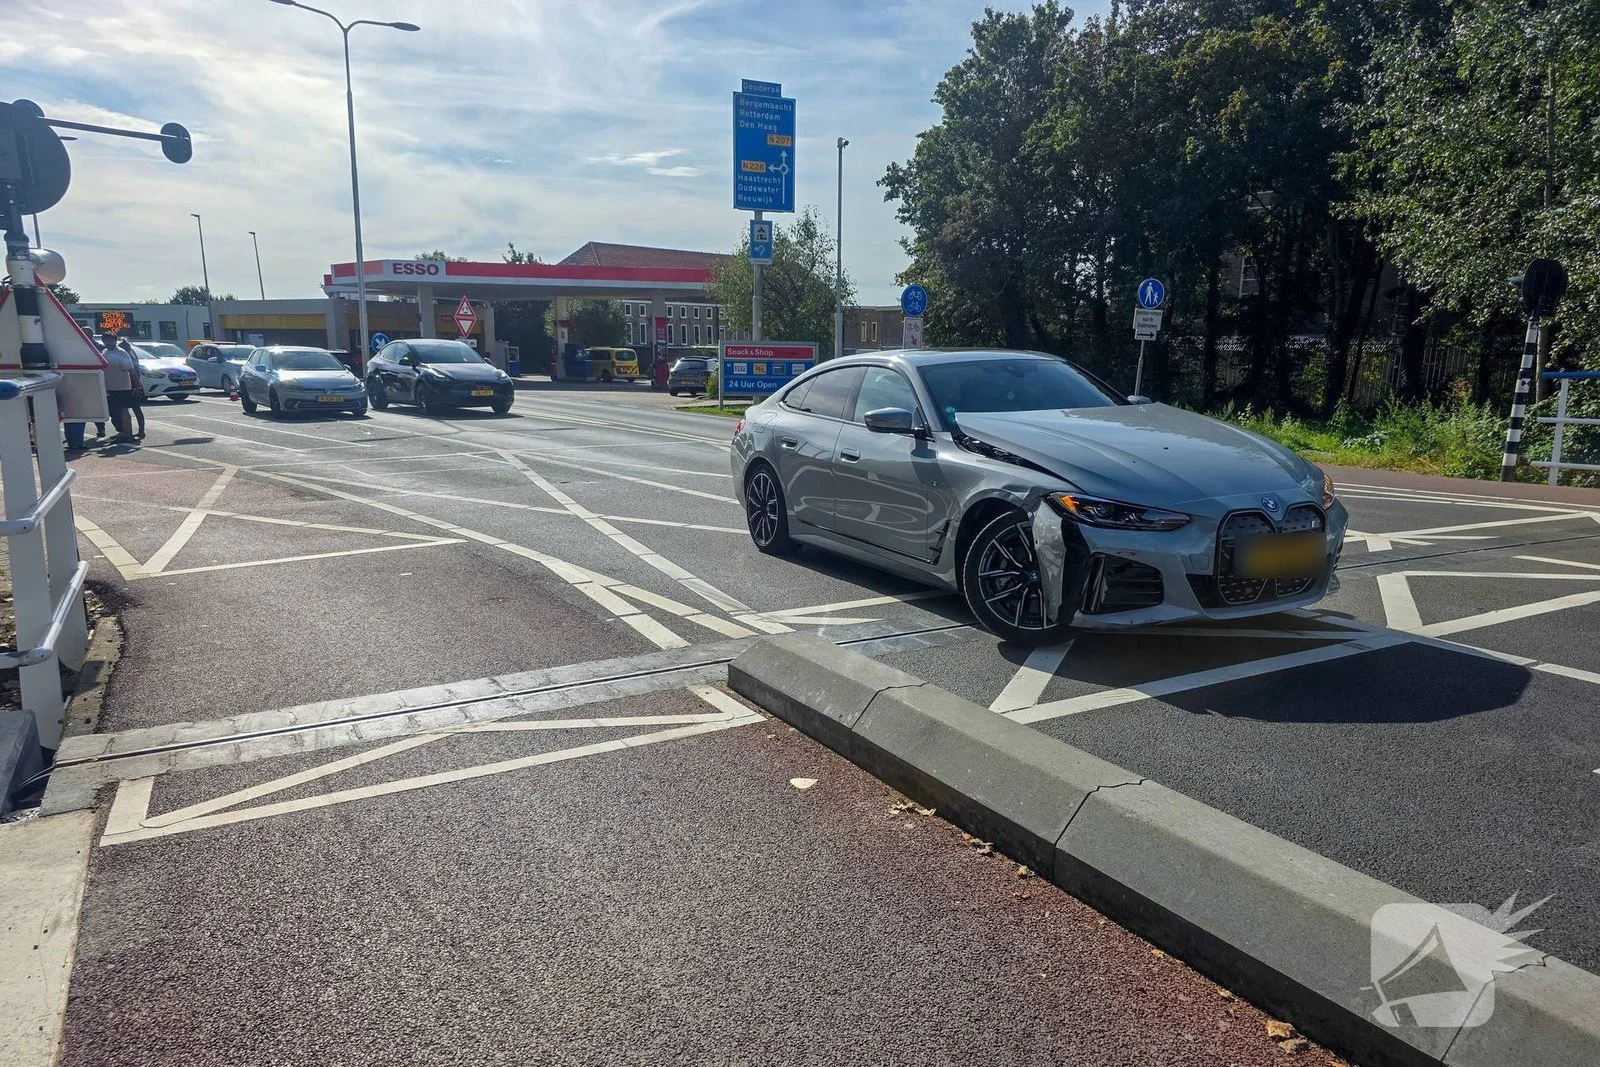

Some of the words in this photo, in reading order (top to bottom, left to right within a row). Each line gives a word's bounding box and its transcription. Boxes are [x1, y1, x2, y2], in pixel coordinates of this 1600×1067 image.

[740, 98, 792, 111] Bergambacht
[740, 109, 781, 120] Rotterdam
[740, 120, 755, 129] Den
[758, 122, 778, 133] Haag
[769, 136, 790, 145] N207
[743, 162, 765, 171] N228
[737, 174, 780, 184] Haastrecht
[737, 183, 779, 193] Oudewater
[737, 194, 773, 204] Reeuwijk
[392, 262, 440, 276] ESSO
[727, 347, 749, 356] Snack
[755, 348, 774, 357] Shop
[729, 380, 739, 388] 24
[757, 381, 777, 390] Open
